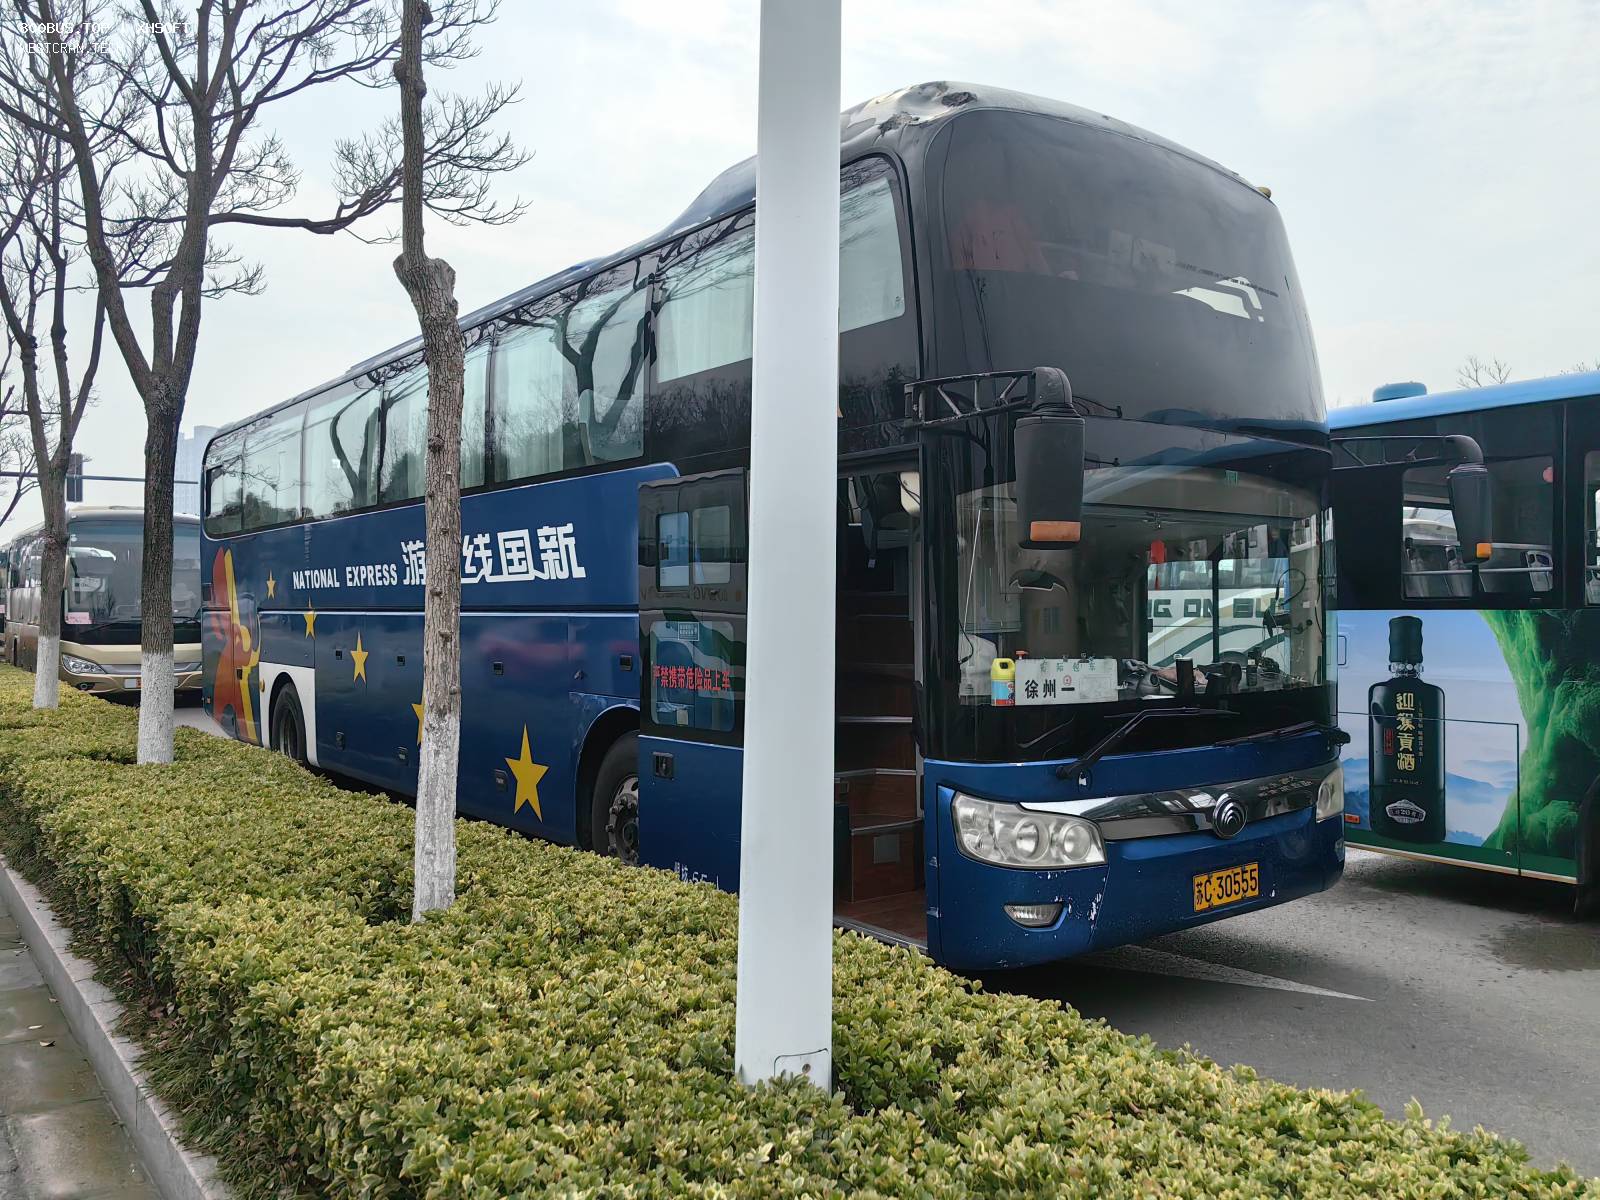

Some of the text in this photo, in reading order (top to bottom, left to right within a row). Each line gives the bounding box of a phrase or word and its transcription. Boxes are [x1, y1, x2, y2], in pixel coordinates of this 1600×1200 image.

[293, 563, 398, 590] NATIONAL EXPRESS
[1233, 598, 1284, 618] BU
